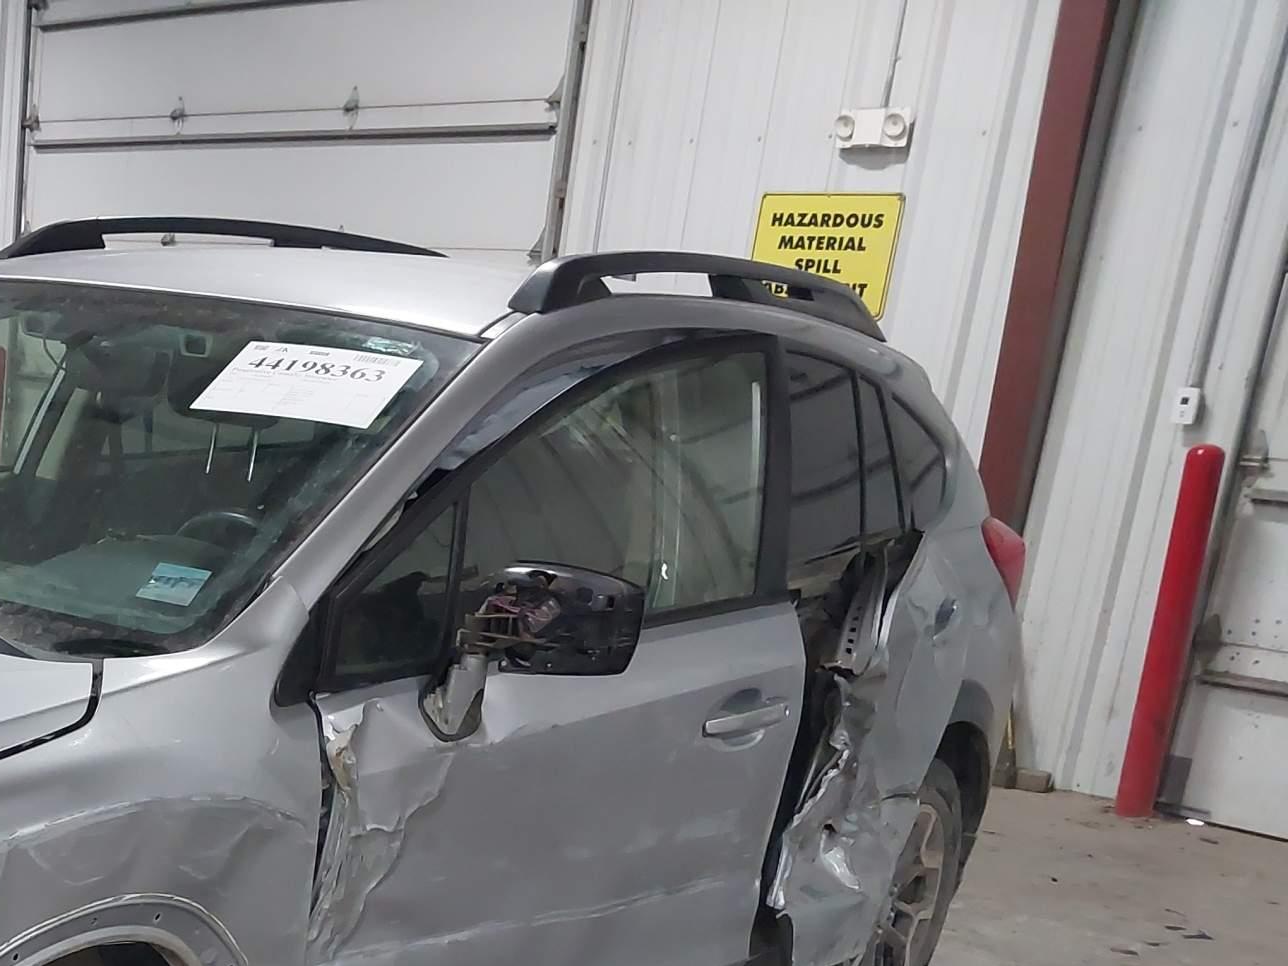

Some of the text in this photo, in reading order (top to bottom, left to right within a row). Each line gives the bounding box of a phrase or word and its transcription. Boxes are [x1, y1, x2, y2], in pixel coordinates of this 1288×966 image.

[771, 213, 885, 228] HAZARDOUS
[778, 235, 866, 251] MATERIAL
[794, 258, 841, 274] SPILL
[248, 355, 386, 383] 44198363
